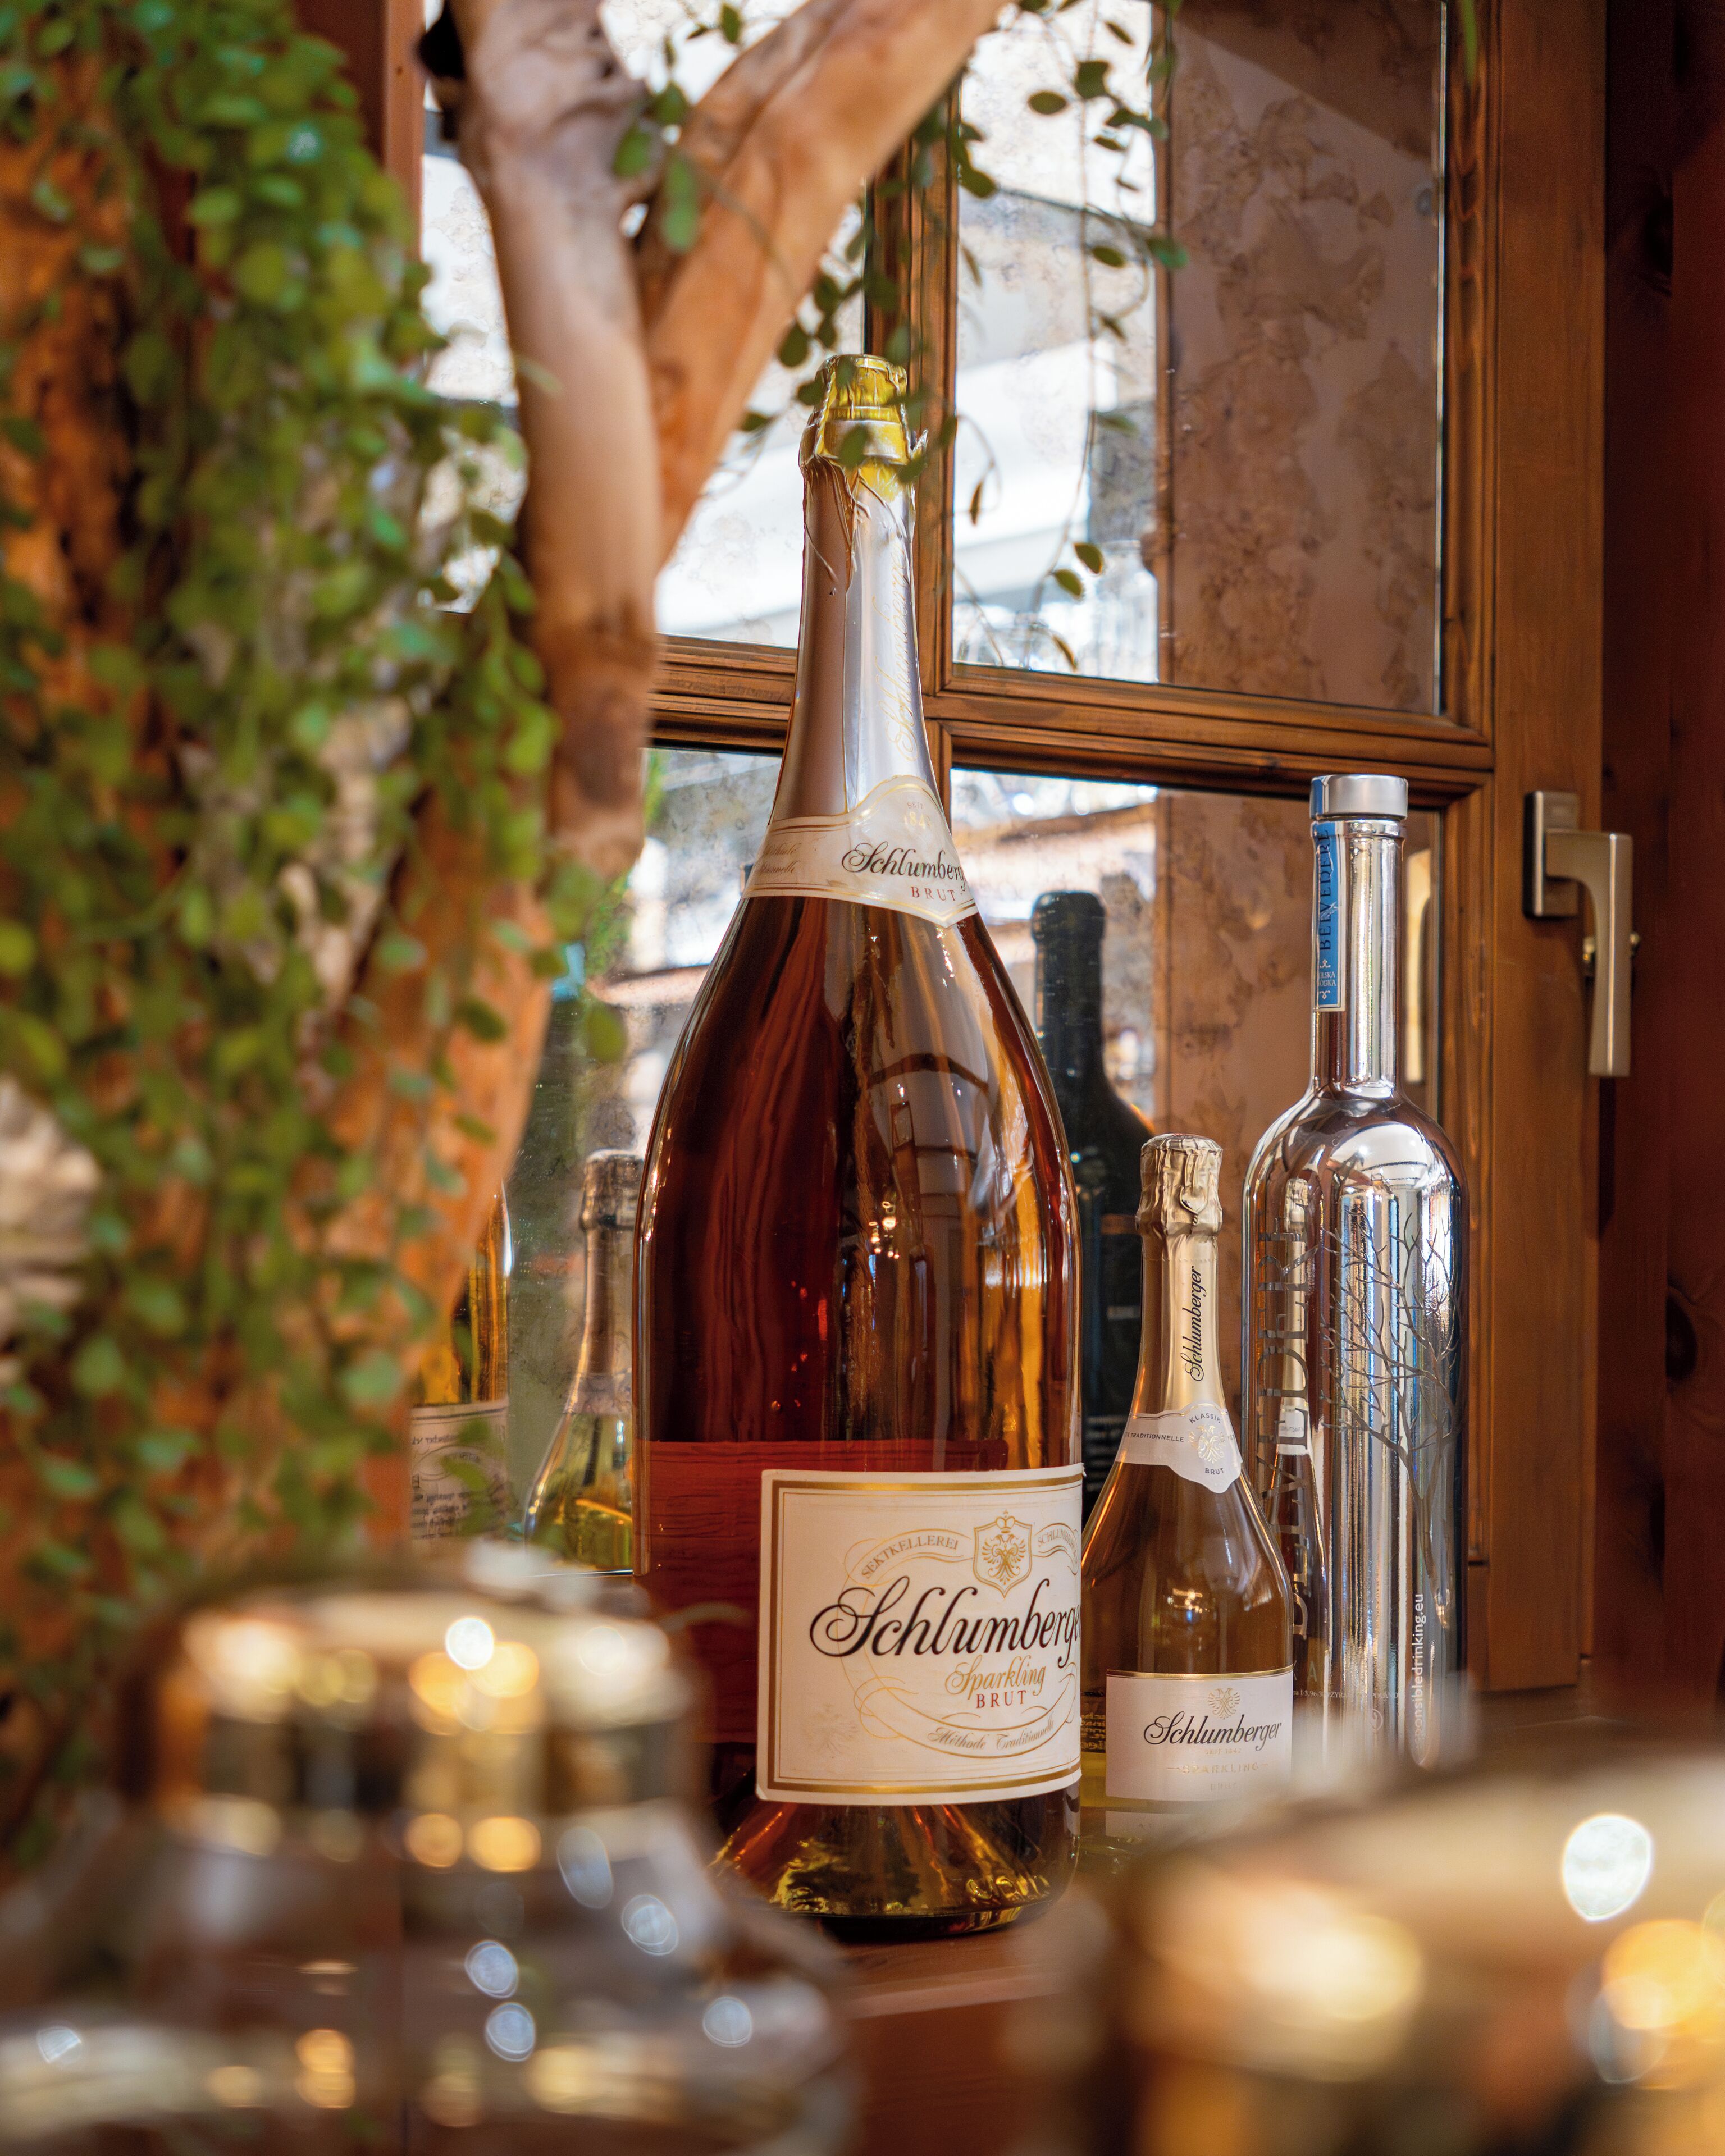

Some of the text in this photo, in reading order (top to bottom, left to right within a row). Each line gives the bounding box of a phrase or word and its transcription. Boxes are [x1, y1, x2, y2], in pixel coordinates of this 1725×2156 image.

[911, 885, 957, 902] BRUT
[1179, 1265, 1207, 1382] Schlumberger
[1189, 1413, 1221, 1424] KLASSIK
[1131, 1432, 1184, 1442] TRADITIONNELLE
[861, 1535, 959, 1579] SEKTKELLEREI
[944, 1654, 1047, 1700] Sparkling
[976, 1689, 1027, 1709] BRUT
[1143, 1711, 1282, 1752] Schlumberger
[1182, 1762, 1258, 1774] SPARKLING
